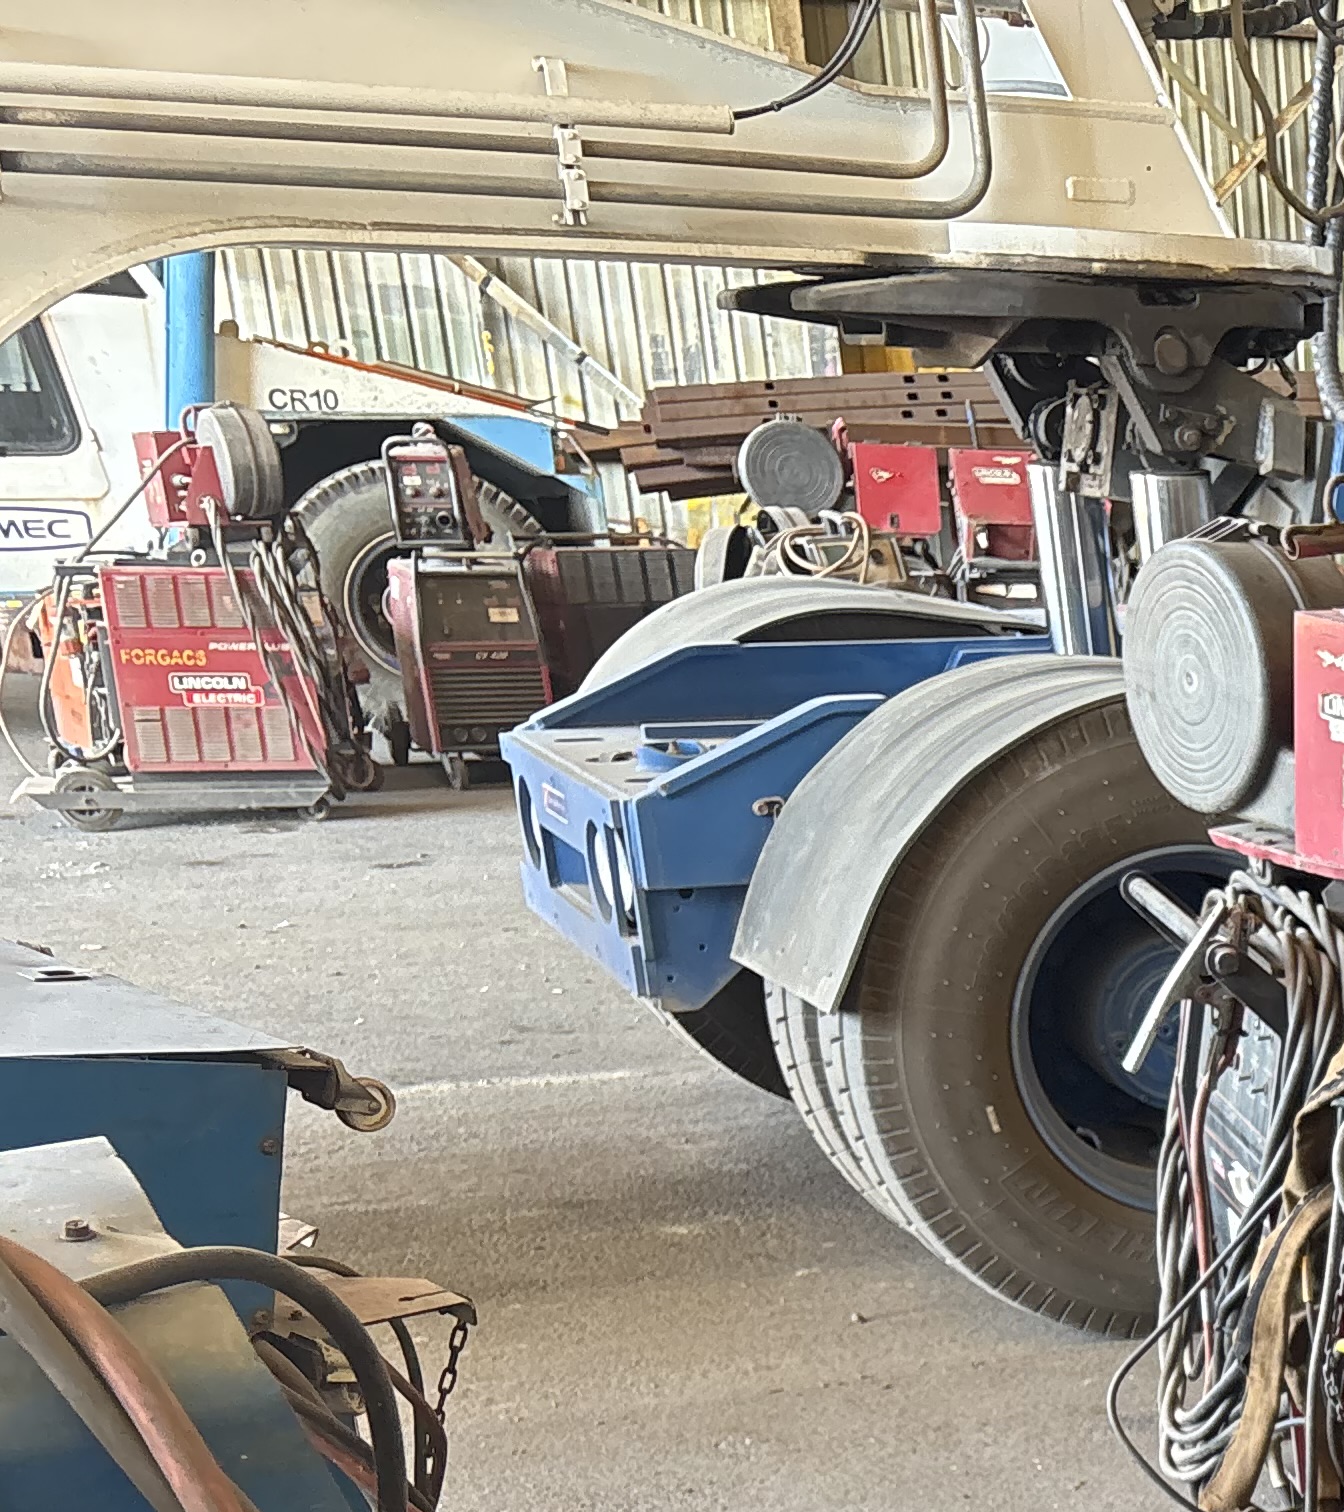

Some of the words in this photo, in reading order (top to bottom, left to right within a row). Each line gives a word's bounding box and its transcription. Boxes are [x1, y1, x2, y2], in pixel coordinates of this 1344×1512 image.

[268, 388, 339, 412] CR10
[0, 519, 71, 540] MEC
[120, 648, 207, 667] FORGACS
[173, 676, 247, 690] LINCOLN
[192, 692, 256, 704] ELECTRIC
